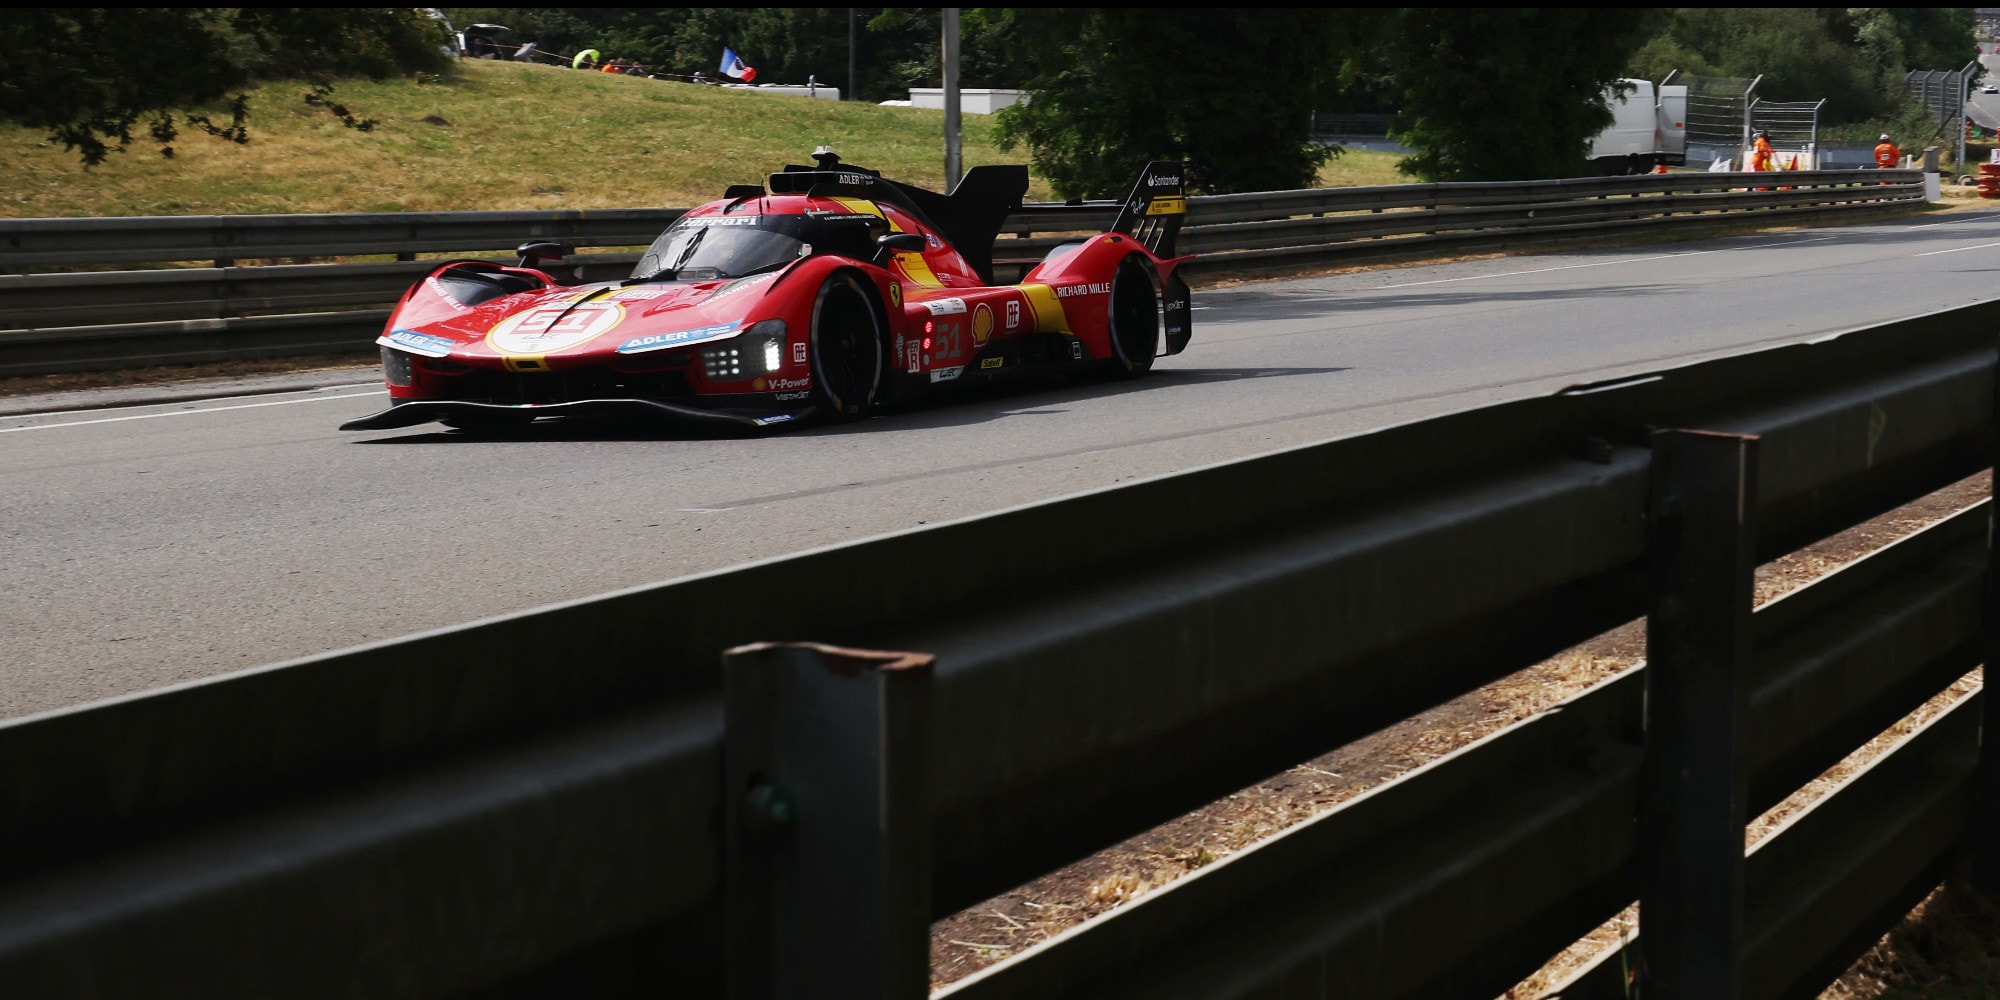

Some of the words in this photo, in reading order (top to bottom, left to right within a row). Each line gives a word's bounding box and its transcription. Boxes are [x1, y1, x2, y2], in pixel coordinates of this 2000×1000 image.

[839, 174, 860, 185] ADLER
[1154, 174, 1180, 187] Santander
[678, 215, 757, 228] Ferrari
[1056, 285, 1088, 298] RICHARD
[1089, 282, 1111, 294] MILLE
[516, 311, 595, 331] 51
[391, 331, 430, 345] ADLER
[626, 331, 689, 348] ADLER
[935, 323, 961, 359] 51
[768, 378, 810, 390] V-Power
